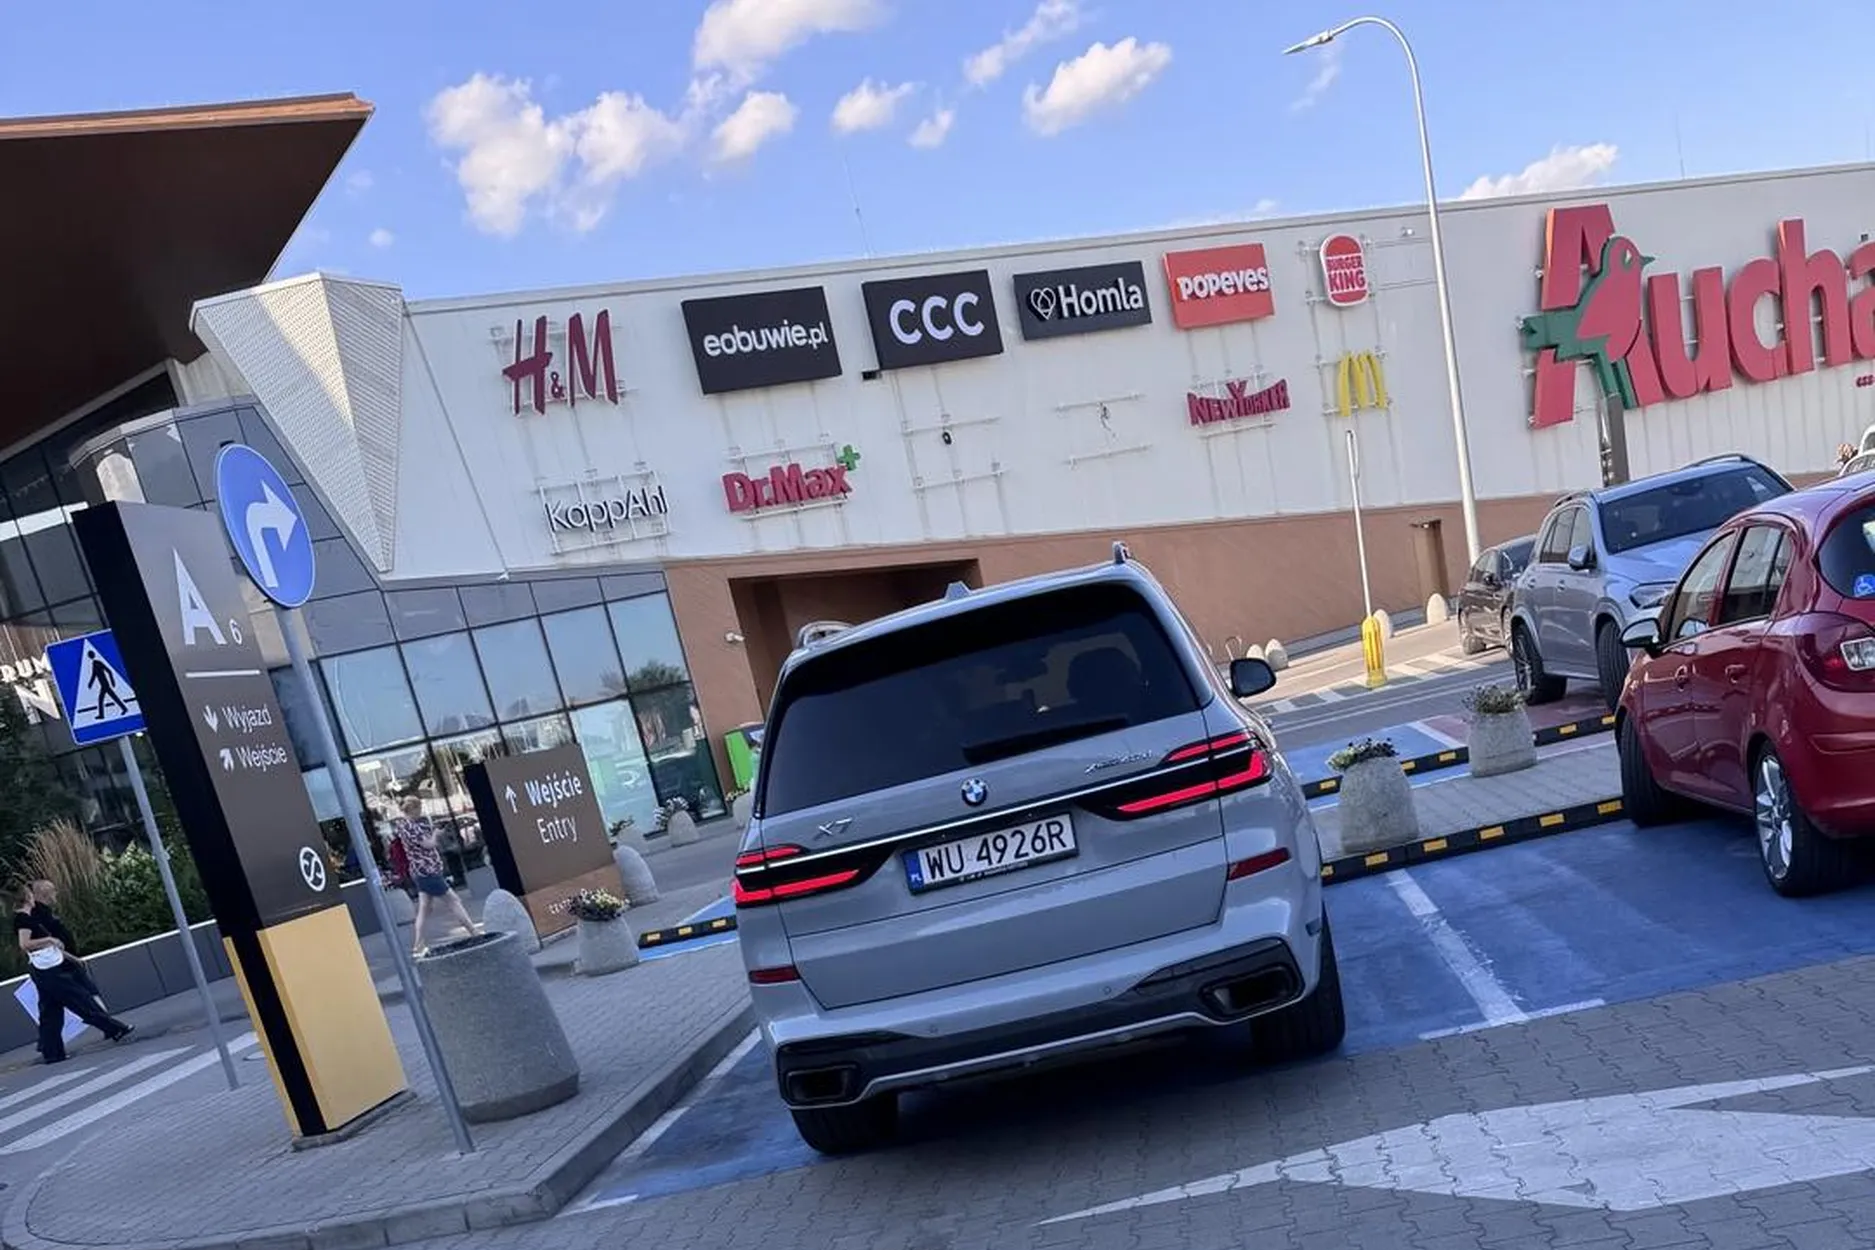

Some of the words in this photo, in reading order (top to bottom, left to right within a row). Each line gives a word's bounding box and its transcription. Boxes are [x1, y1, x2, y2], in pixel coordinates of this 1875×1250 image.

[1326, 255, 1364, 272] BURGER
[1328, 270, 1366, 292] KING
[1057, 276, 1145, 318] Homla
[703, 319, 829, 357] eobuwie.pl
[889, 291, 984, 345] CCC
[502, 309, 619, 416] H&M
[722, 463, 852, 513] Dr.Max
[544, 485, 670, 533] KappAhl
[173, 547, 227, 645] A
[229, 618, 242, 645] 6
[222, 704, 272, 733] Wyjazd
[236, 743, 287, 772] Wejście
[525, 770, 583, 809] Wejście
[537, 815, 578, 844] Entry
[925, 844, 965, 880] WU
[976, 820, 1067, 866] 4926R
